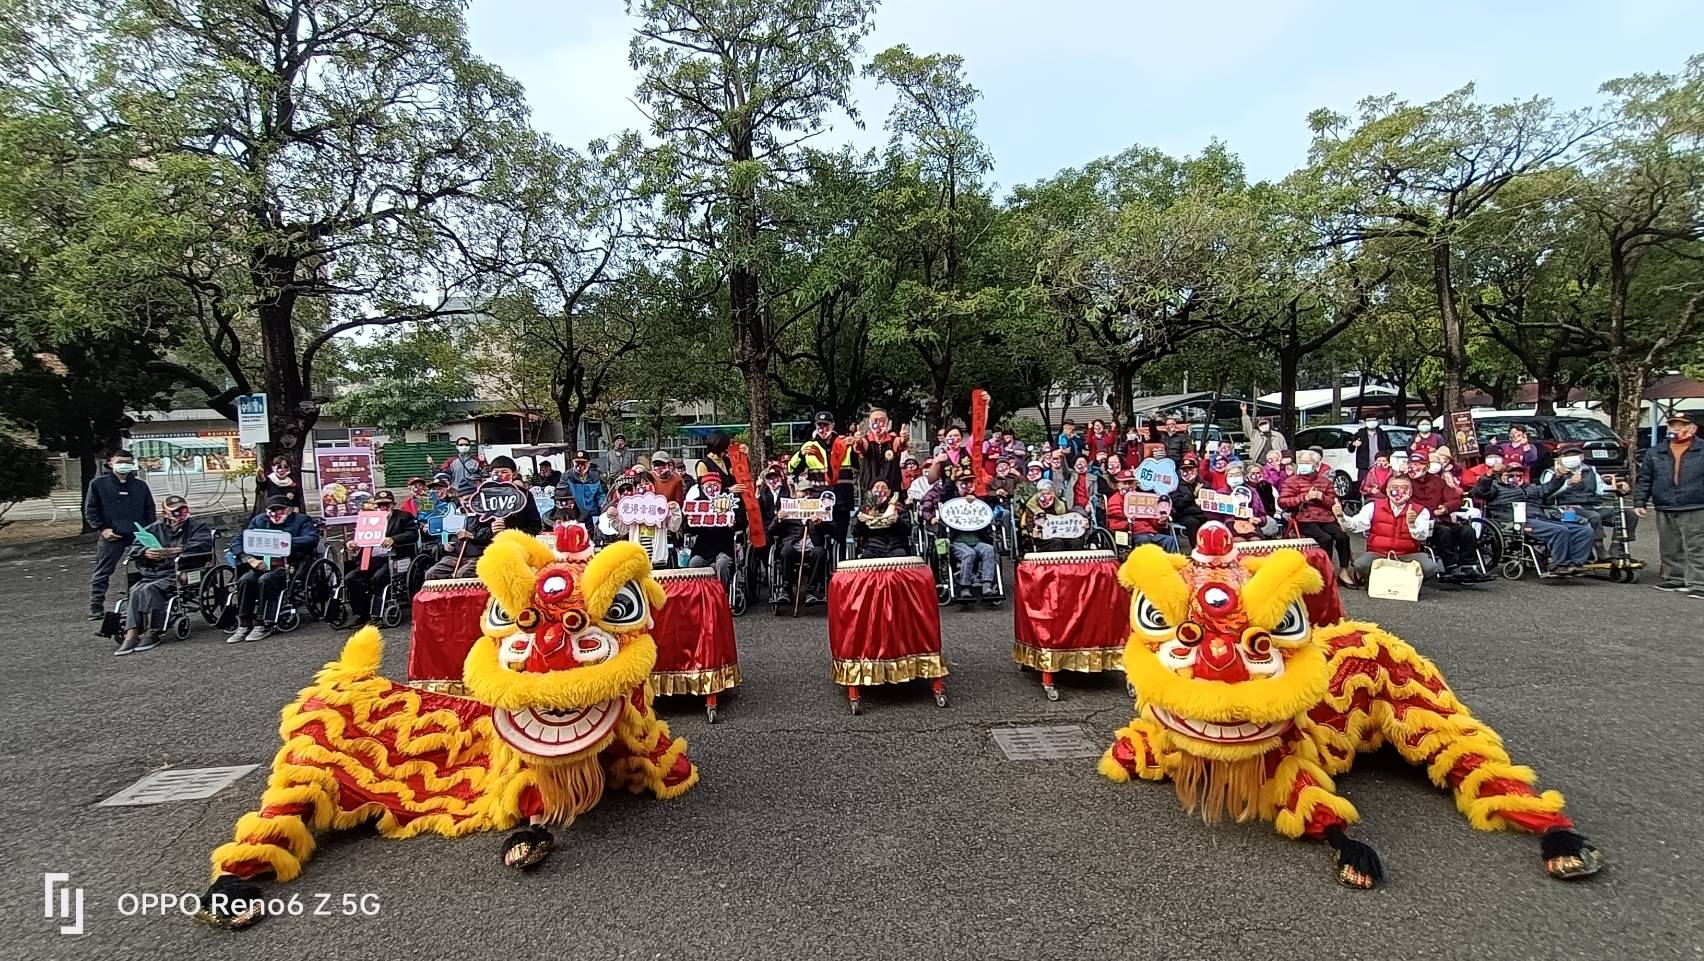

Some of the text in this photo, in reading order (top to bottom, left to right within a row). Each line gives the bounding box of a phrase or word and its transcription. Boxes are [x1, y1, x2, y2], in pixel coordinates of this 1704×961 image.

[1141, 468, 1172, 484] 防詐騙
[480, 492, 517, 511] Love
[622, 503, 657, 515] 覺得幸福
[362, 516, 368, 526] I
[357, 530, 382, 541] YOU
